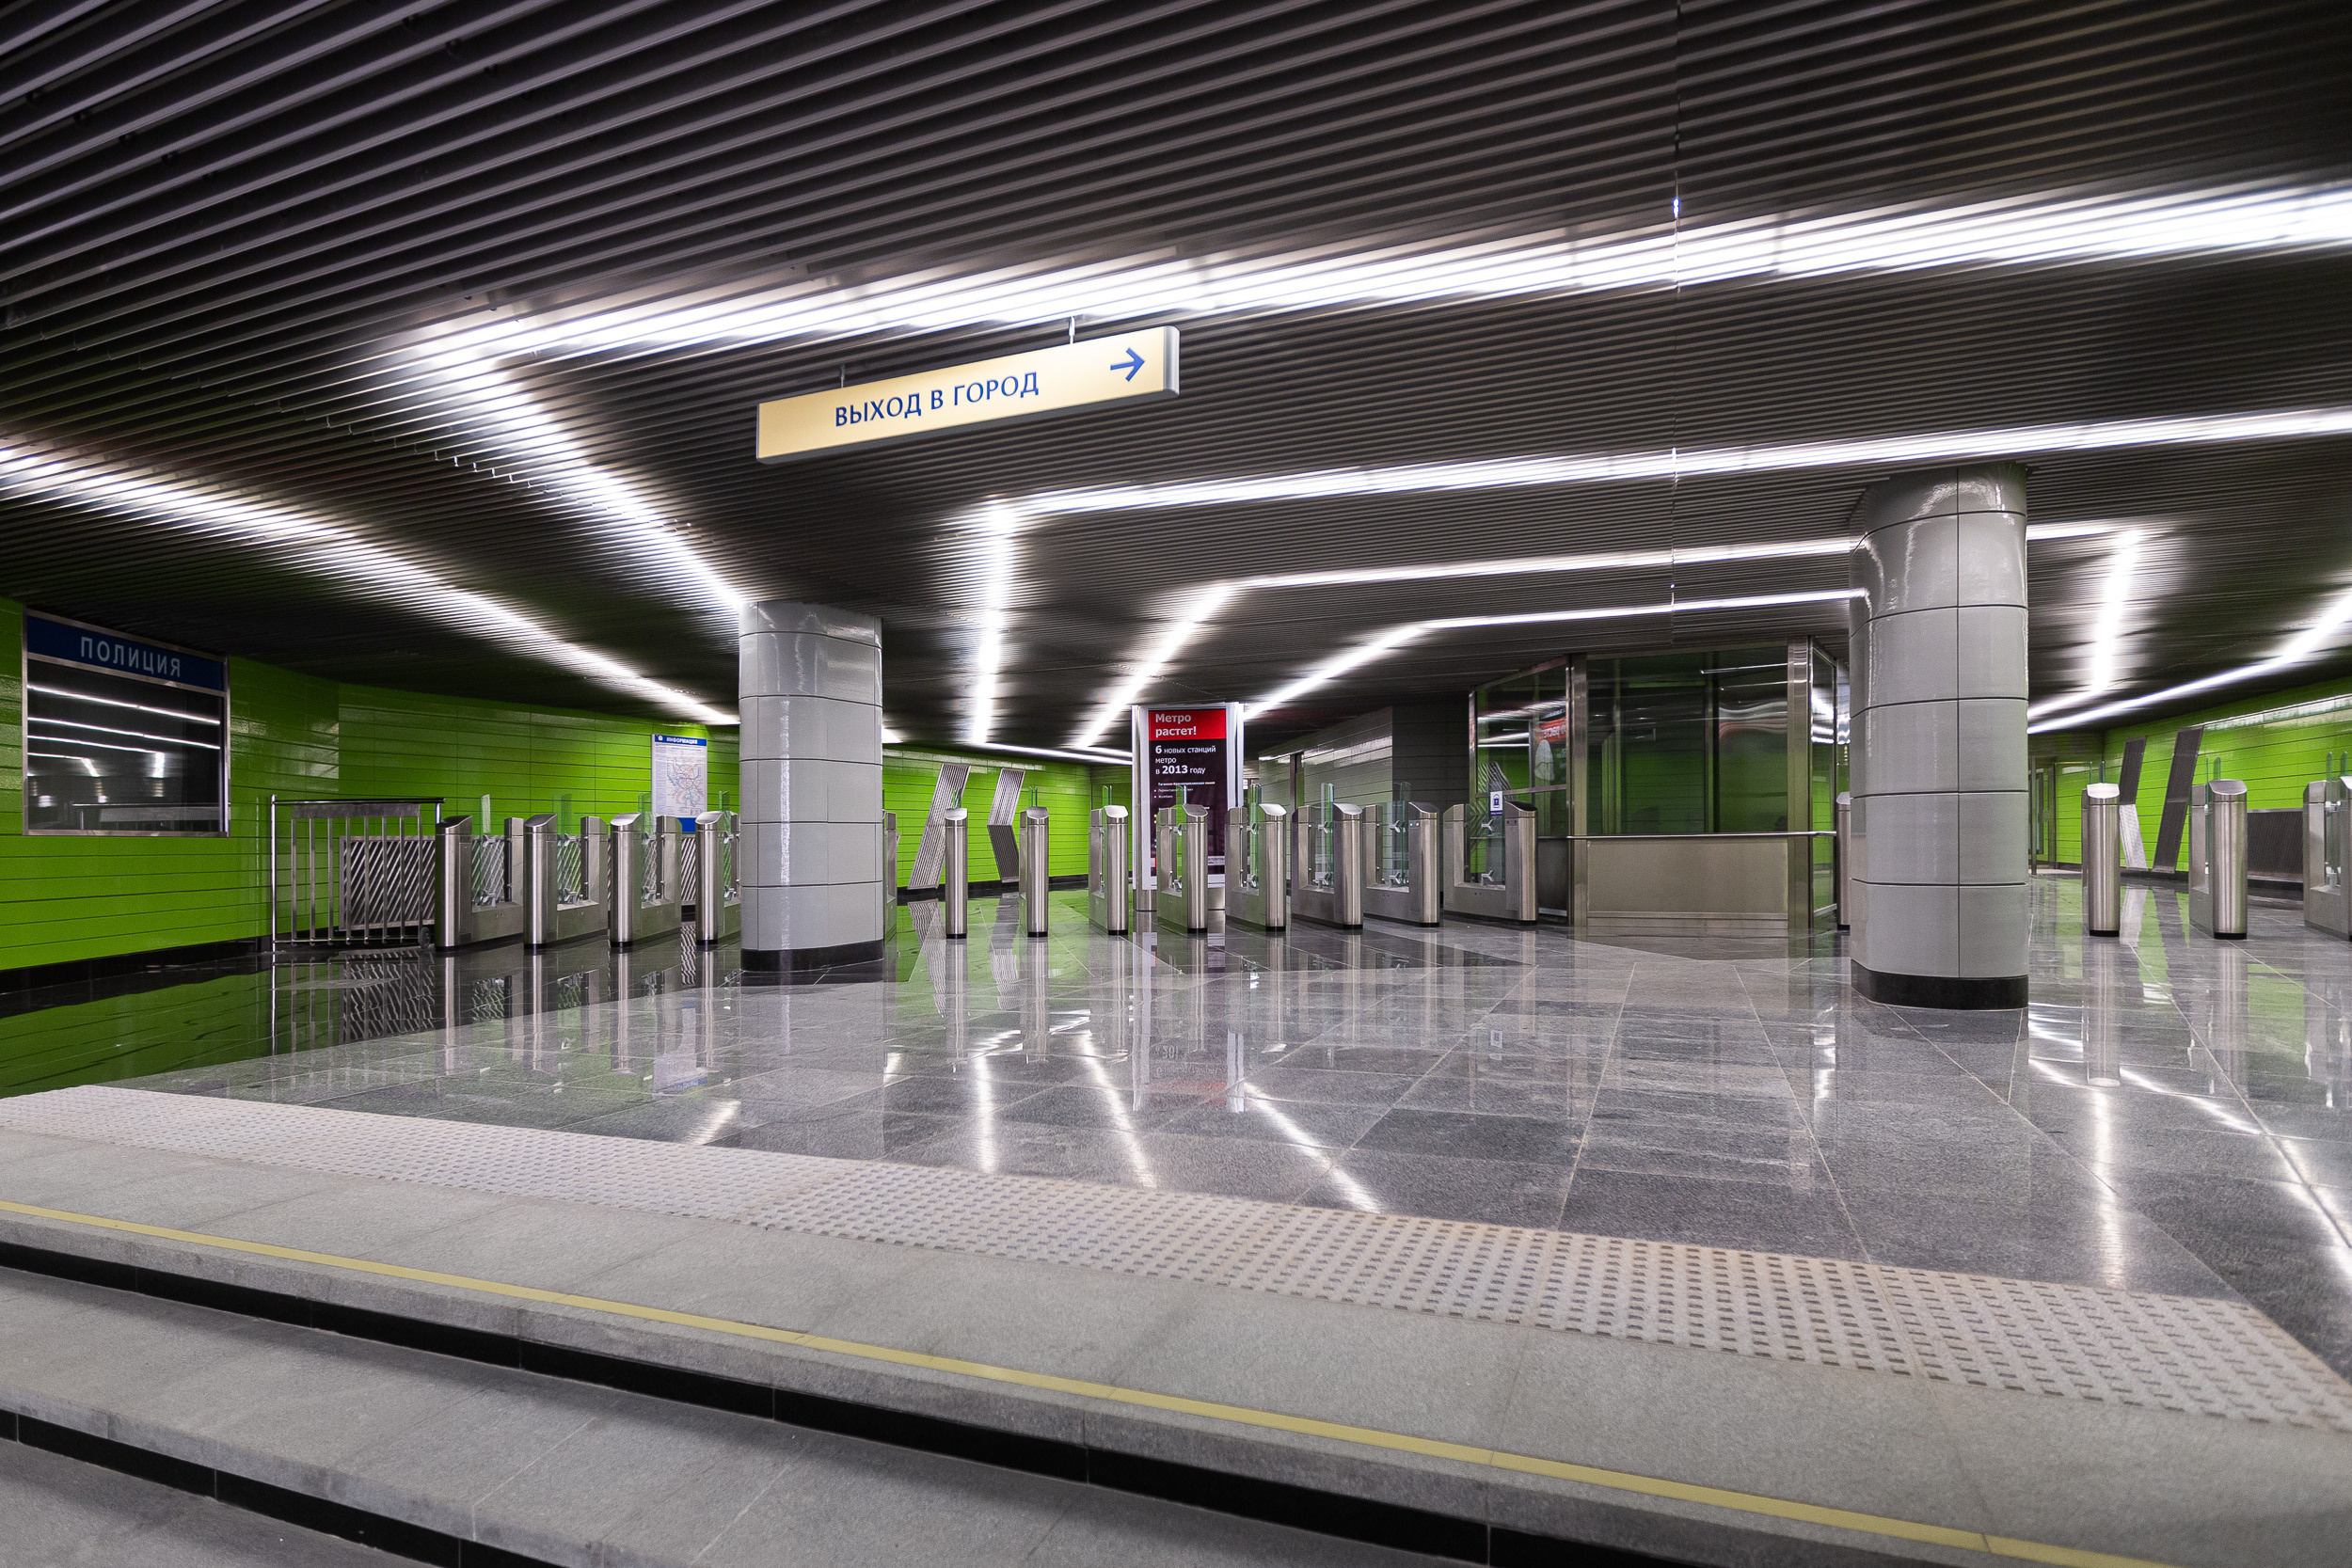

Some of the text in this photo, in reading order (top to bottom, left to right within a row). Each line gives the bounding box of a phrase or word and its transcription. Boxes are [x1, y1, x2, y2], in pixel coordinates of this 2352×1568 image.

[834, 371, 1040, 428] ВЫХОД В ГОРОД
[80, 635, 182, 678] ПОЛИЦИЯ
[1155, 713, 1192, 725] Метро
[1155, 725, 1197, 738] растет!
[1154, 745, 1163, 754] 6
[1187, 745, 1216, 754] станций
[1162, 765, 1188, 775] 2013
